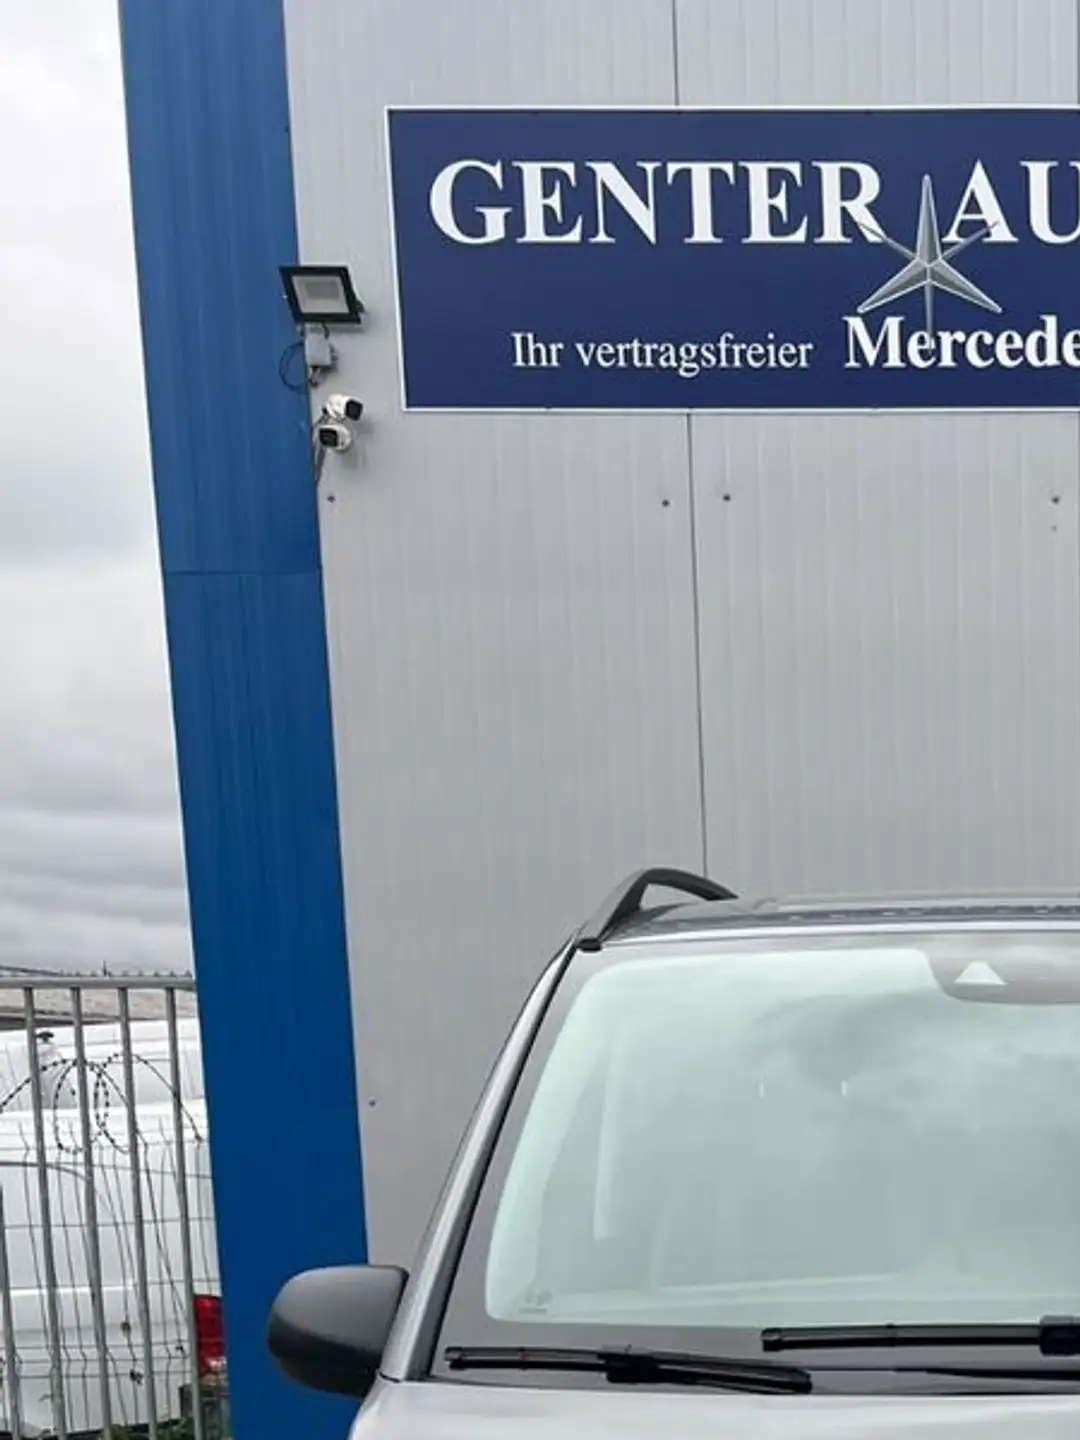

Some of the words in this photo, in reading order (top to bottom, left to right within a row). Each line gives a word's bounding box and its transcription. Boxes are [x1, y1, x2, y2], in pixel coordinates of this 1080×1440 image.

[429, 158, 884, 245] GENTER
[510, 332, 563, 368] Ihr
[574, 332, 814, 378] vertragsfreier
